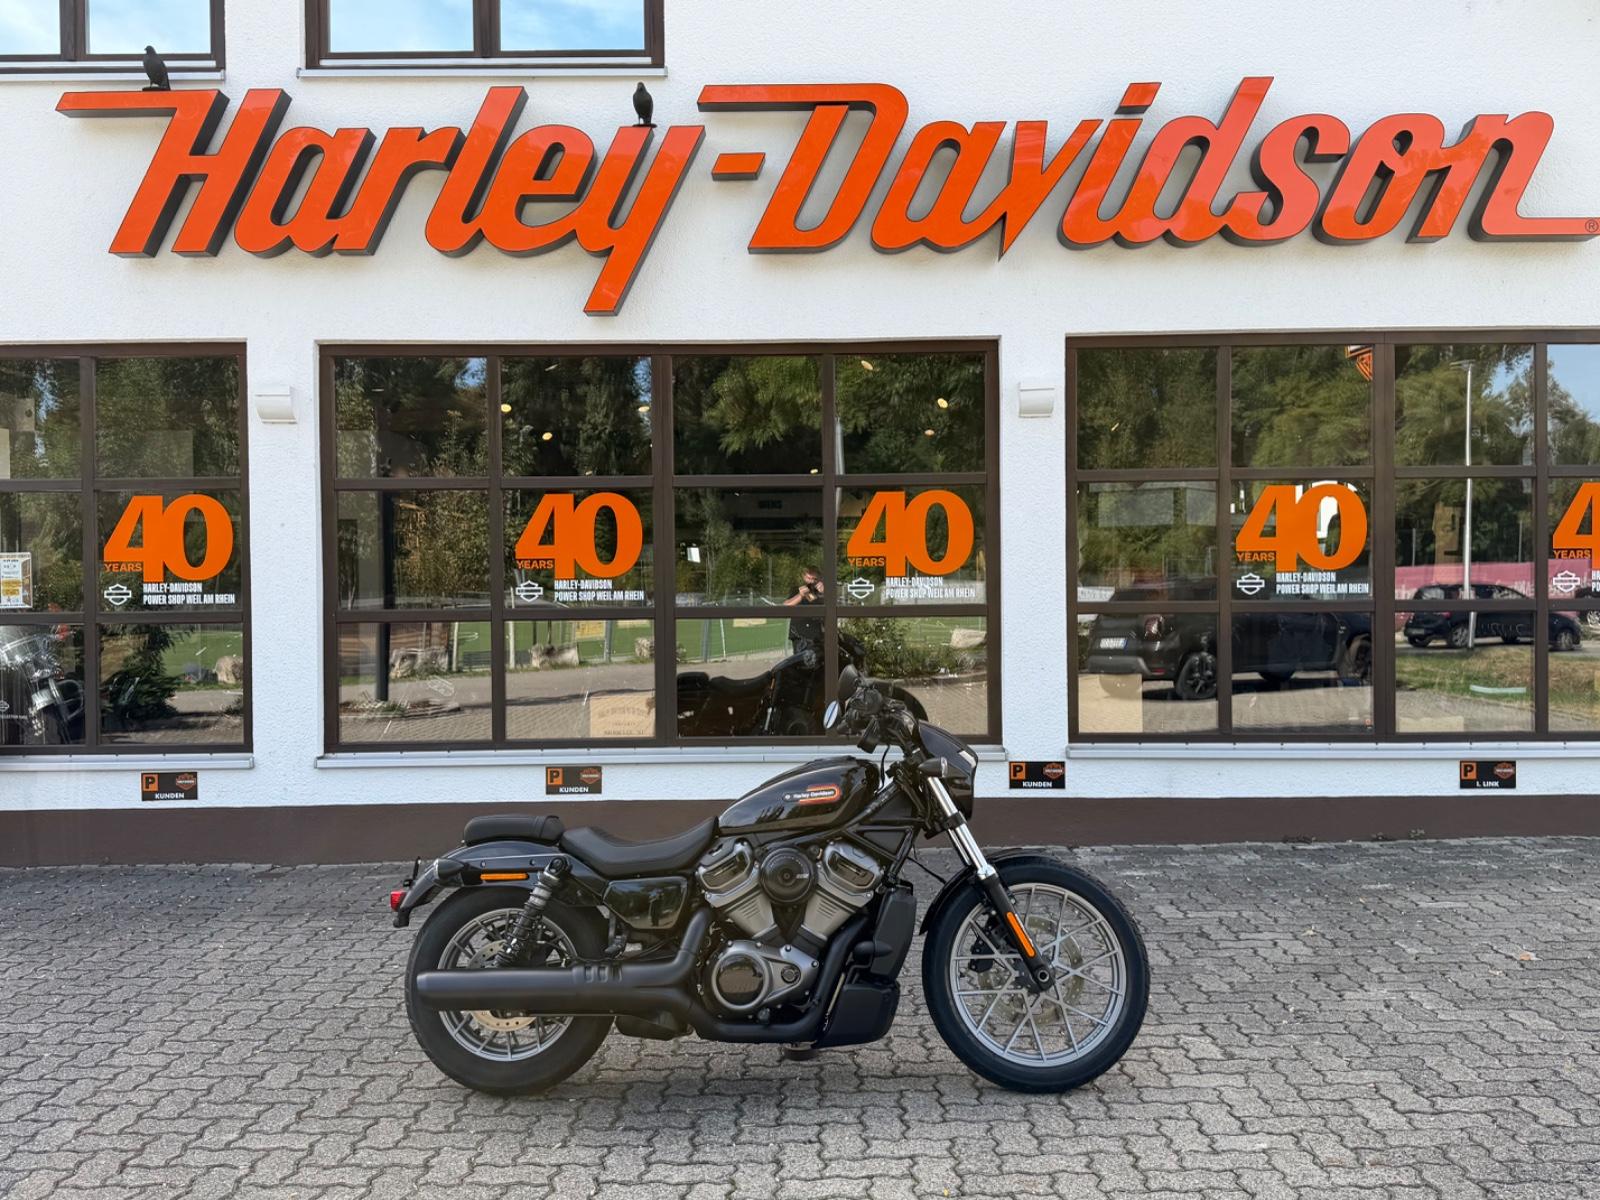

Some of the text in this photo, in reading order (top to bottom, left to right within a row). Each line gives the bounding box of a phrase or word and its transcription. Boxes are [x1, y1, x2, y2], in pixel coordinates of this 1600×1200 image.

[55, 77, 1600, 314] Harley-Davidson
[1236, 483, 1368, 572] 40
[1553, 482, 1600, 570] 4
[104, 494, 234, 582] 40
[515, 492, 643, 579] 40
[847, 489, 974, 577] 40
[1236, 552, 1275, 562] YEARS
[1554, 550, 1591, 559] YEARS
[104, 562, 143, 573] YEARS
[516, 560, 554, 569] YEARS
[848, 557, 885, 567] YEARS
[1276, 572, 1336, 582] HARLEY-DAVIDSON
[143, 583, 202, 593] HARLEY-DAVIDSON
[554, 579, 612, 590] HARLEY-DAVIDSON
[550, 770, 560, 783] P
[1013, 764, 1023, 777] P
[1464, 764, 1474, 777] P
[145, 776, 156, 789] P
